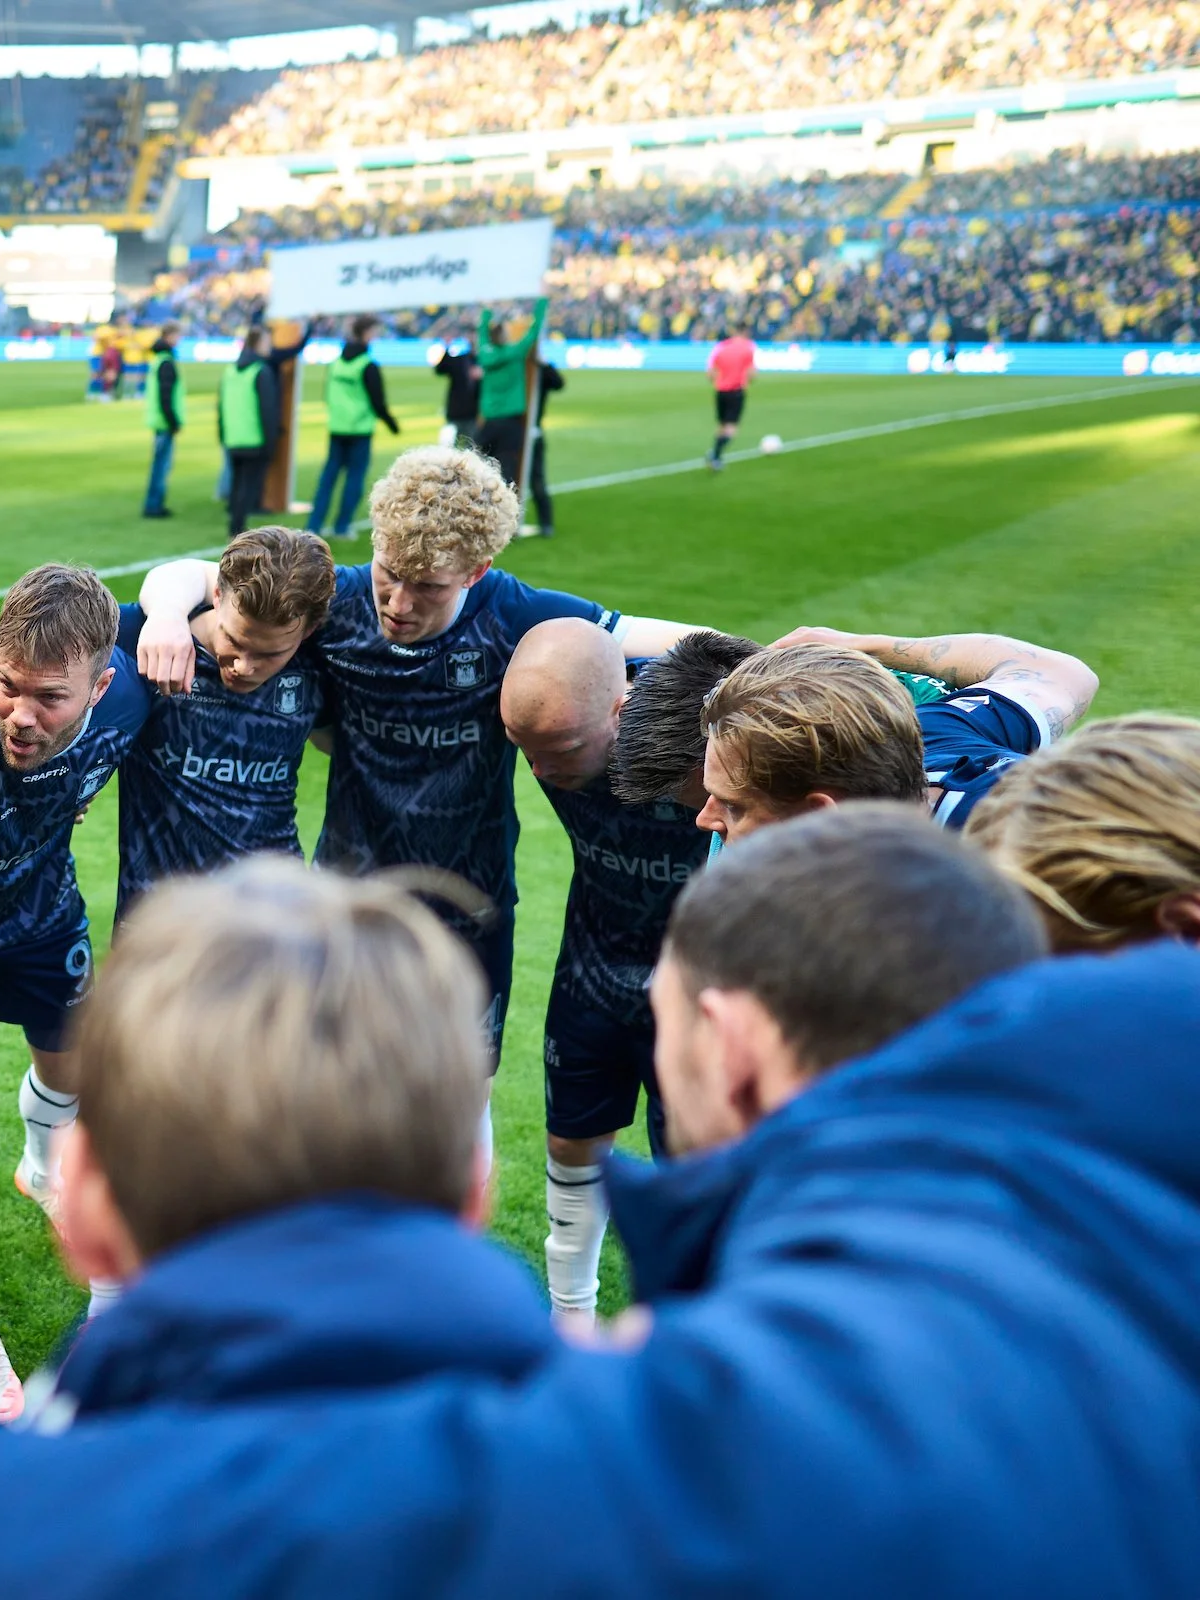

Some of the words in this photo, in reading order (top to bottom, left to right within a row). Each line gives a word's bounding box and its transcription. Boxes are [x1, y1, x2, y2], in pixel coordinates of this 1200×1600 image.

[366, 255, 469, 286] Superliga
[361, 708, 481, 748] bravida
[22, 769, 60, 783] CRAFT
[182, 747, 290, 784] bravida
[572, 832, 691, 883] bravida
[66, 938, 91, 993] 9
